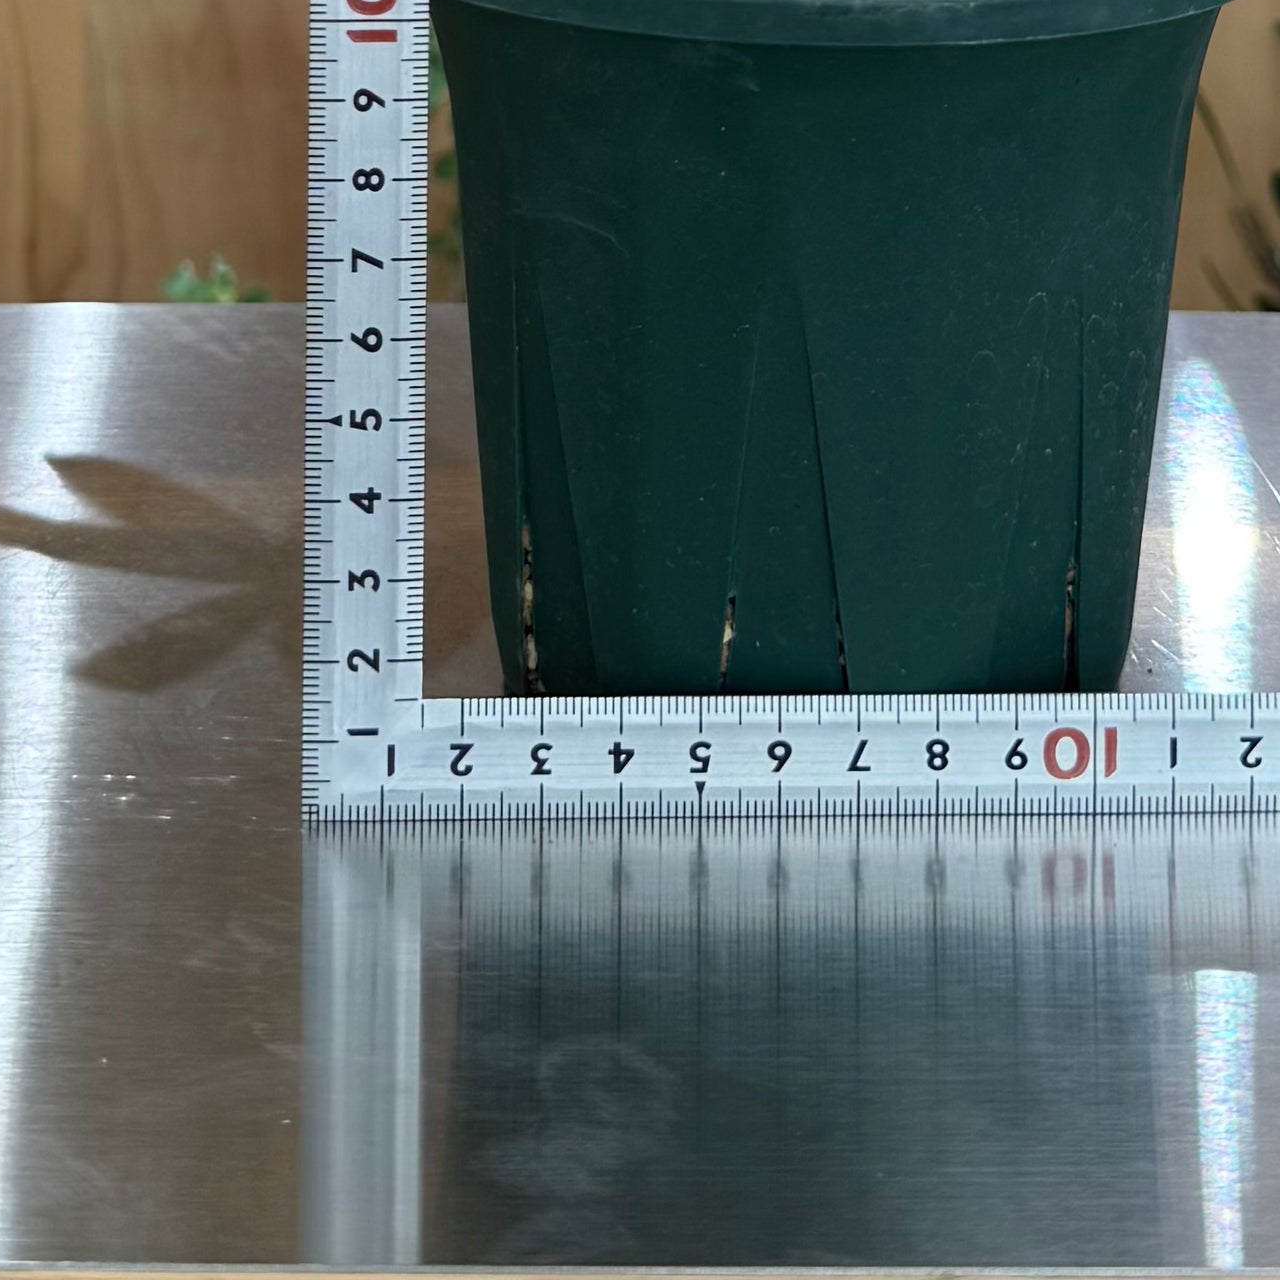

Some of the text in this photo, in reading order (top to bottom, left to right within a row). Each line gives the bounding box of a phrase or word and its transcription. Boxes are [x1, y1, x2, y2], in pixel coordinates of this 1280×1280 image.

[352, 88, 386, 113] 9
[351, 167, 386, 193] 8
[351, 247, 385, 274] 7
[350, 326, 384, 353] 6
[349, 408, 383, 432] 5
[348, 486, 382, 515] 4
[347, 569, 381, 593] 3
[346, 648, 380, 673] 2
[347, 728, 379, 736] 1
[387, 744, 396, 777] 1
[449, 743, 475, 777] 2
[530, 742, 553, 776] 3
[607, 741, 635, 775] 4
[689, 741, 712, 774] 5
[767, 740, 793, 773] 6
[847, 739, 872, 772] 7
[925, 738, 950, 771] 8
[1004, 738, 1028, 771] 9
[1042, 726, 1119, 780] 10
[1169, 737, 1178, 769] 1
[1239, 736, 1264, 769] 2
